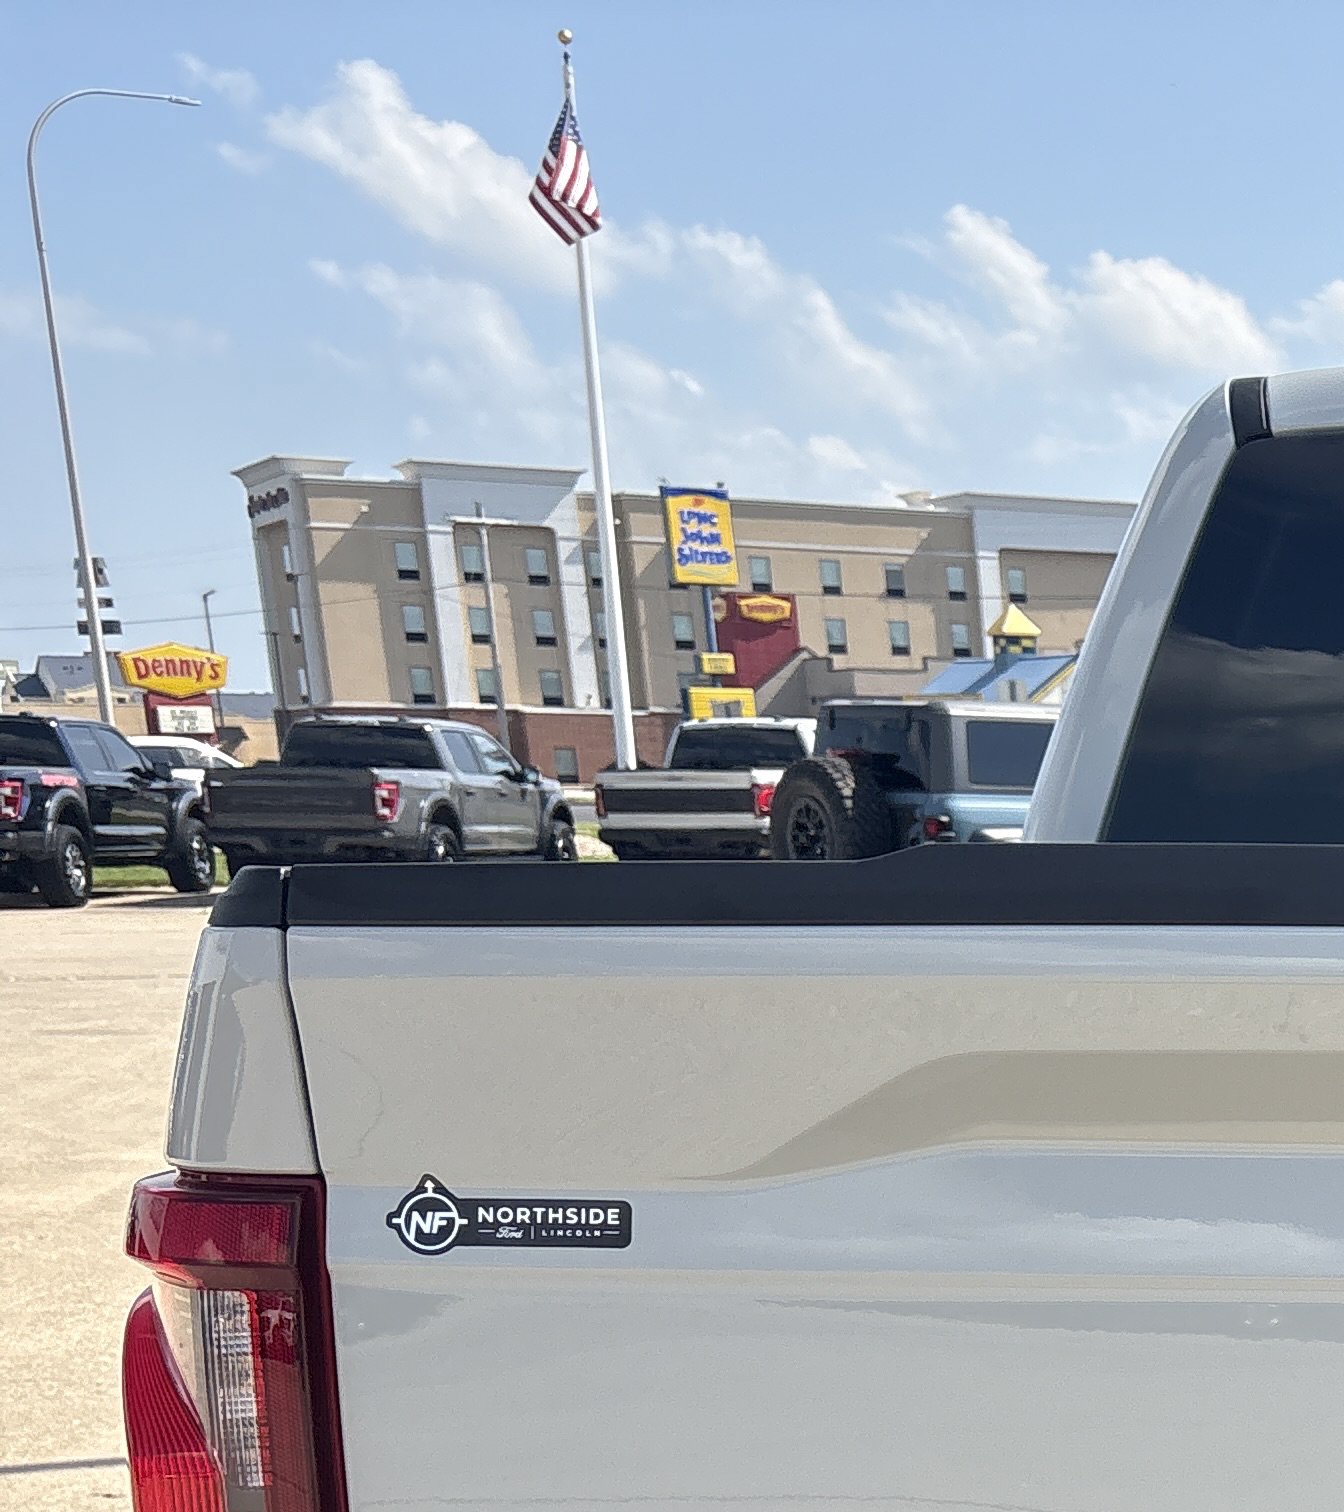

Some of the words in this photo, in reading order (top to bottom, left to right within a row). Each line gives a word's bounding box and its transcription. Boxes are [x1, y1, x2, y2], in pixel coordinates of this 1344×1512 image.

[132, 656, 221, 683] Denny's
[410, 1211, 456, 1242] NF
[478, 1206, 620, 1226] NORTHSIDE
[496, 1226, 525, 1239] Ford
[541, 1229, 601, 1238] LINCOLN
